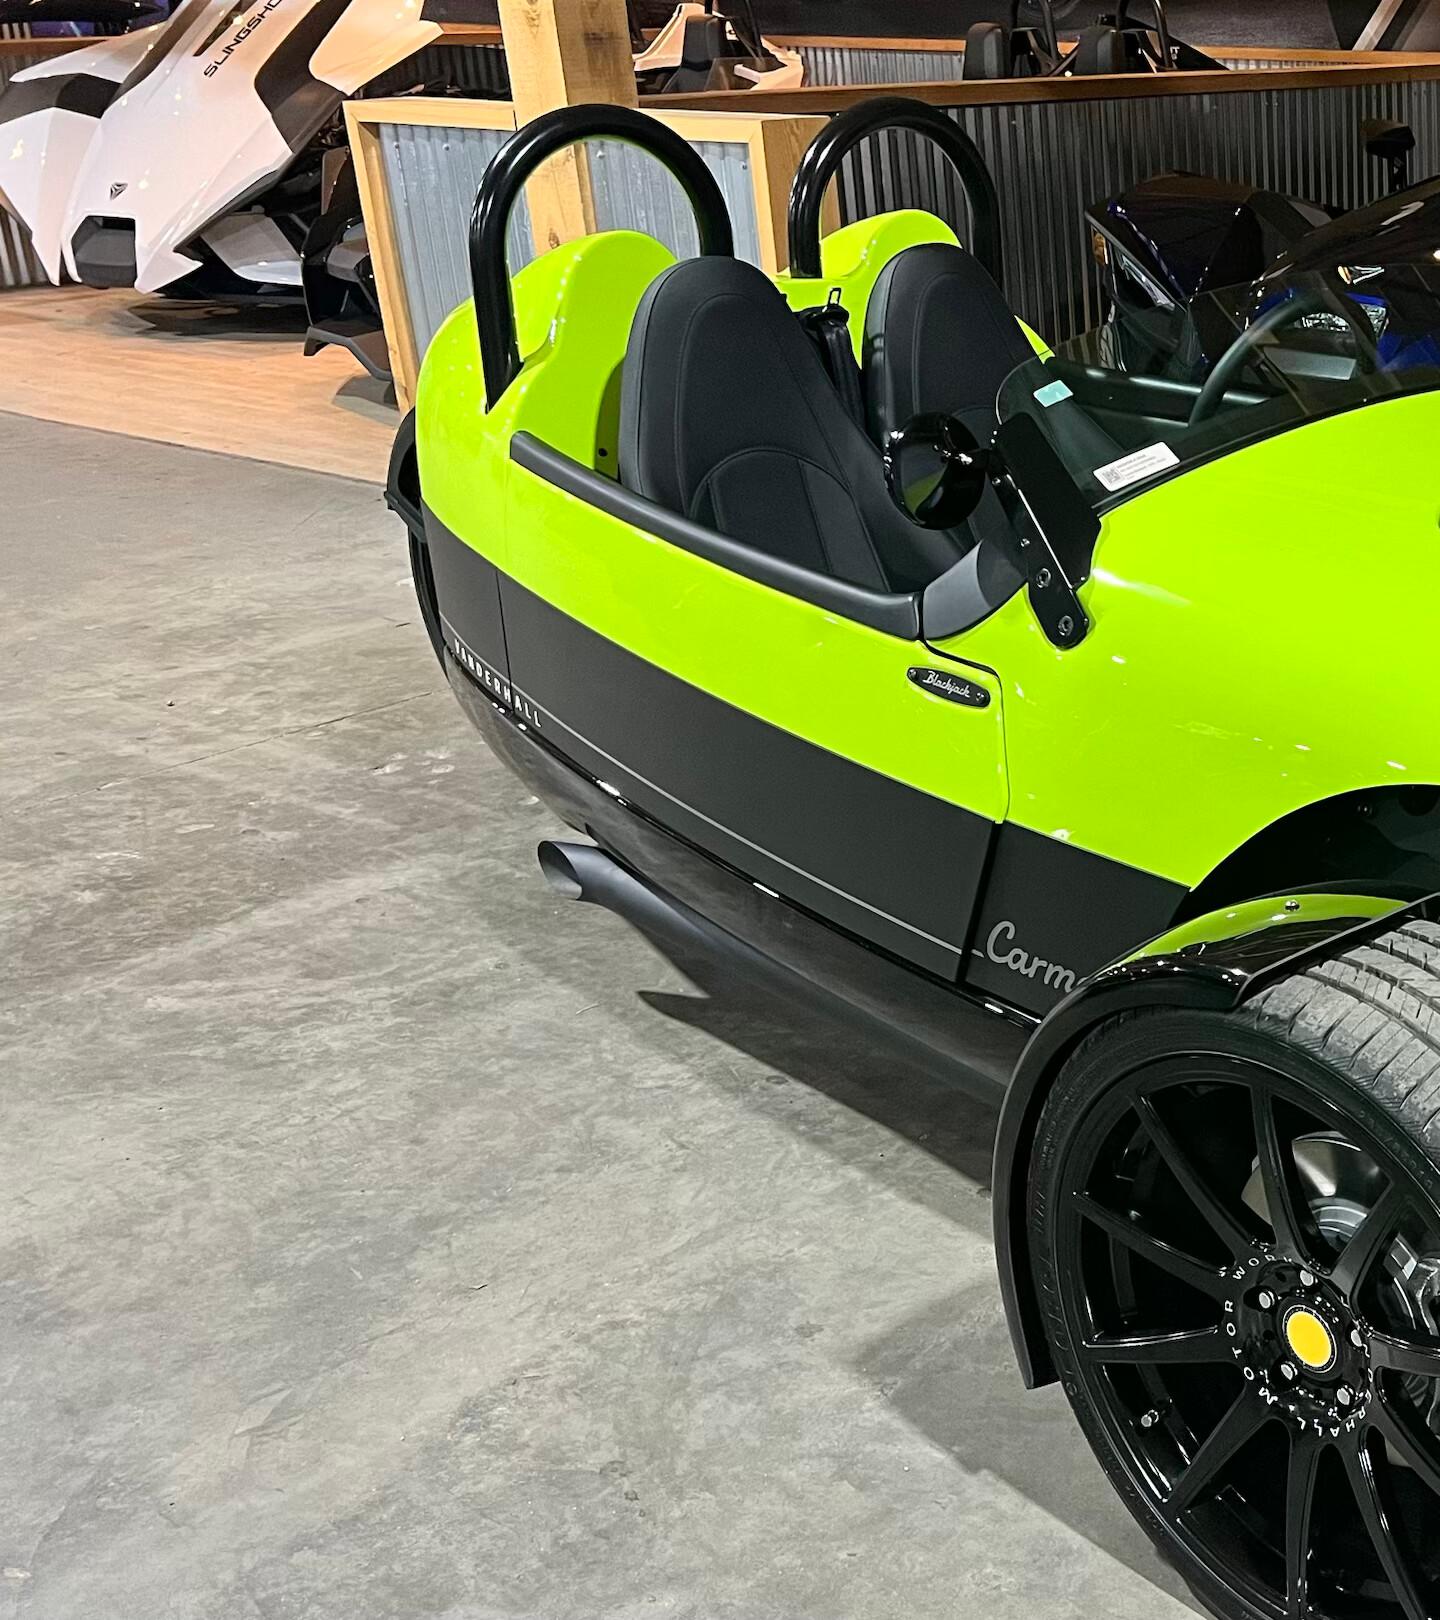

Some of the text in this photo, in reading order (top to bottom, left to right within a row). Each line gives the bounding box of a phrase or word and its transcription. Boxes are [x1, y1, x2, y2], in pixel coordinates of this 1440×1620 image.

[454, 638, 542, 728] VANDERHALL
[922, 670, 971, 699] Blackjack
[986, 920, 1084, 993] Carm
[1224, 1299, 1279, 1406] MOTOR
